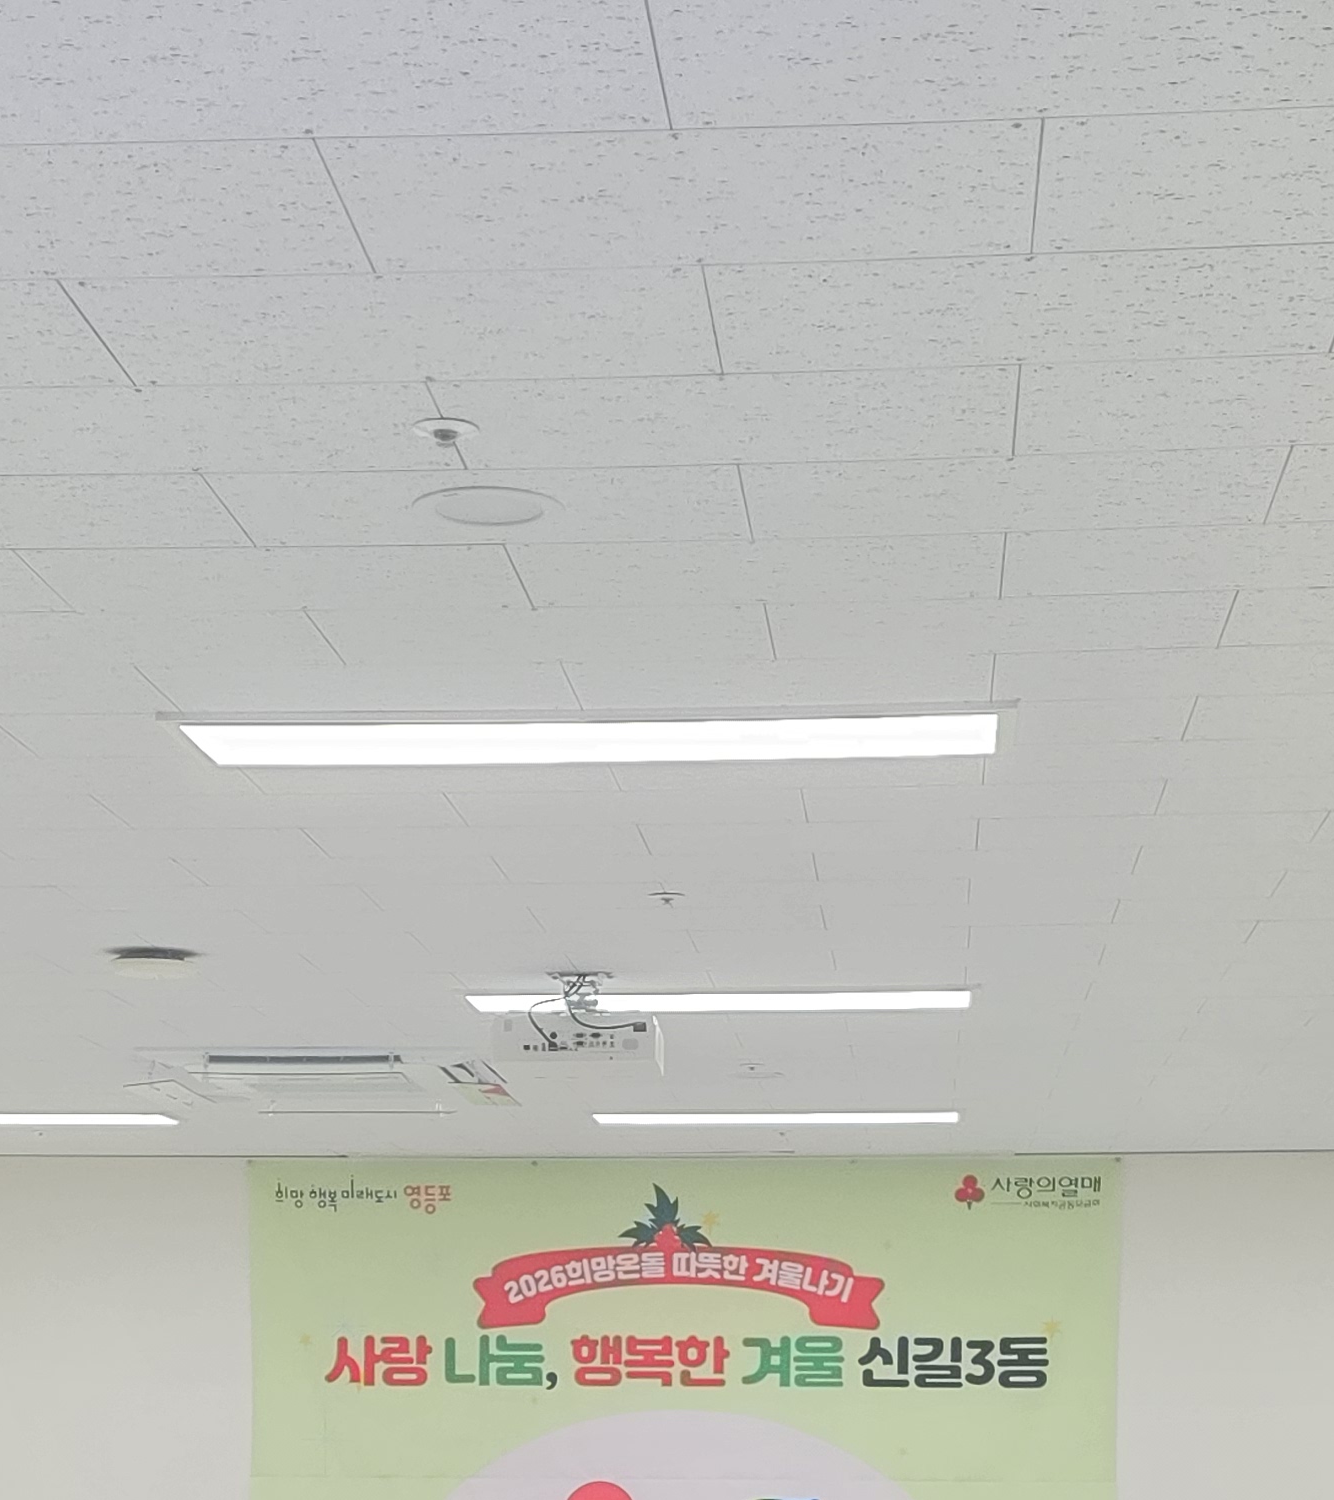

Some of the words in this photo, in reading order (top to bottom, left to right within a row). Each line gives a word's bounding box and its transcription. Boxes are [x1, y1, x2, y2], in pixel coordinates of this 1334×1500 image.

[275, 1178, 304, 1208] 희망
[309, 1184, 337, 1212] 행복
[341, 1175, 397, 1203] 미래도시
[404, 1185, 451, 1214] 영등포
[990, 1176, 1102, 1200] 사랑의열매
[503, 1252, 665, 1304] 2026희망온돌
[671, 1250, 748, 1283] 따뜻한
[752, 1256, 855, 1303] 겨울나기
[324, 1335, 432, 1387] 사랑
[444, 1335, 558, 1391] 나눔,
[569, 1335, 731, 1387] 행복한
[740, 1336, 845, 1387] 겨울
[856, 1336, 1049, 1388] 신길3동
